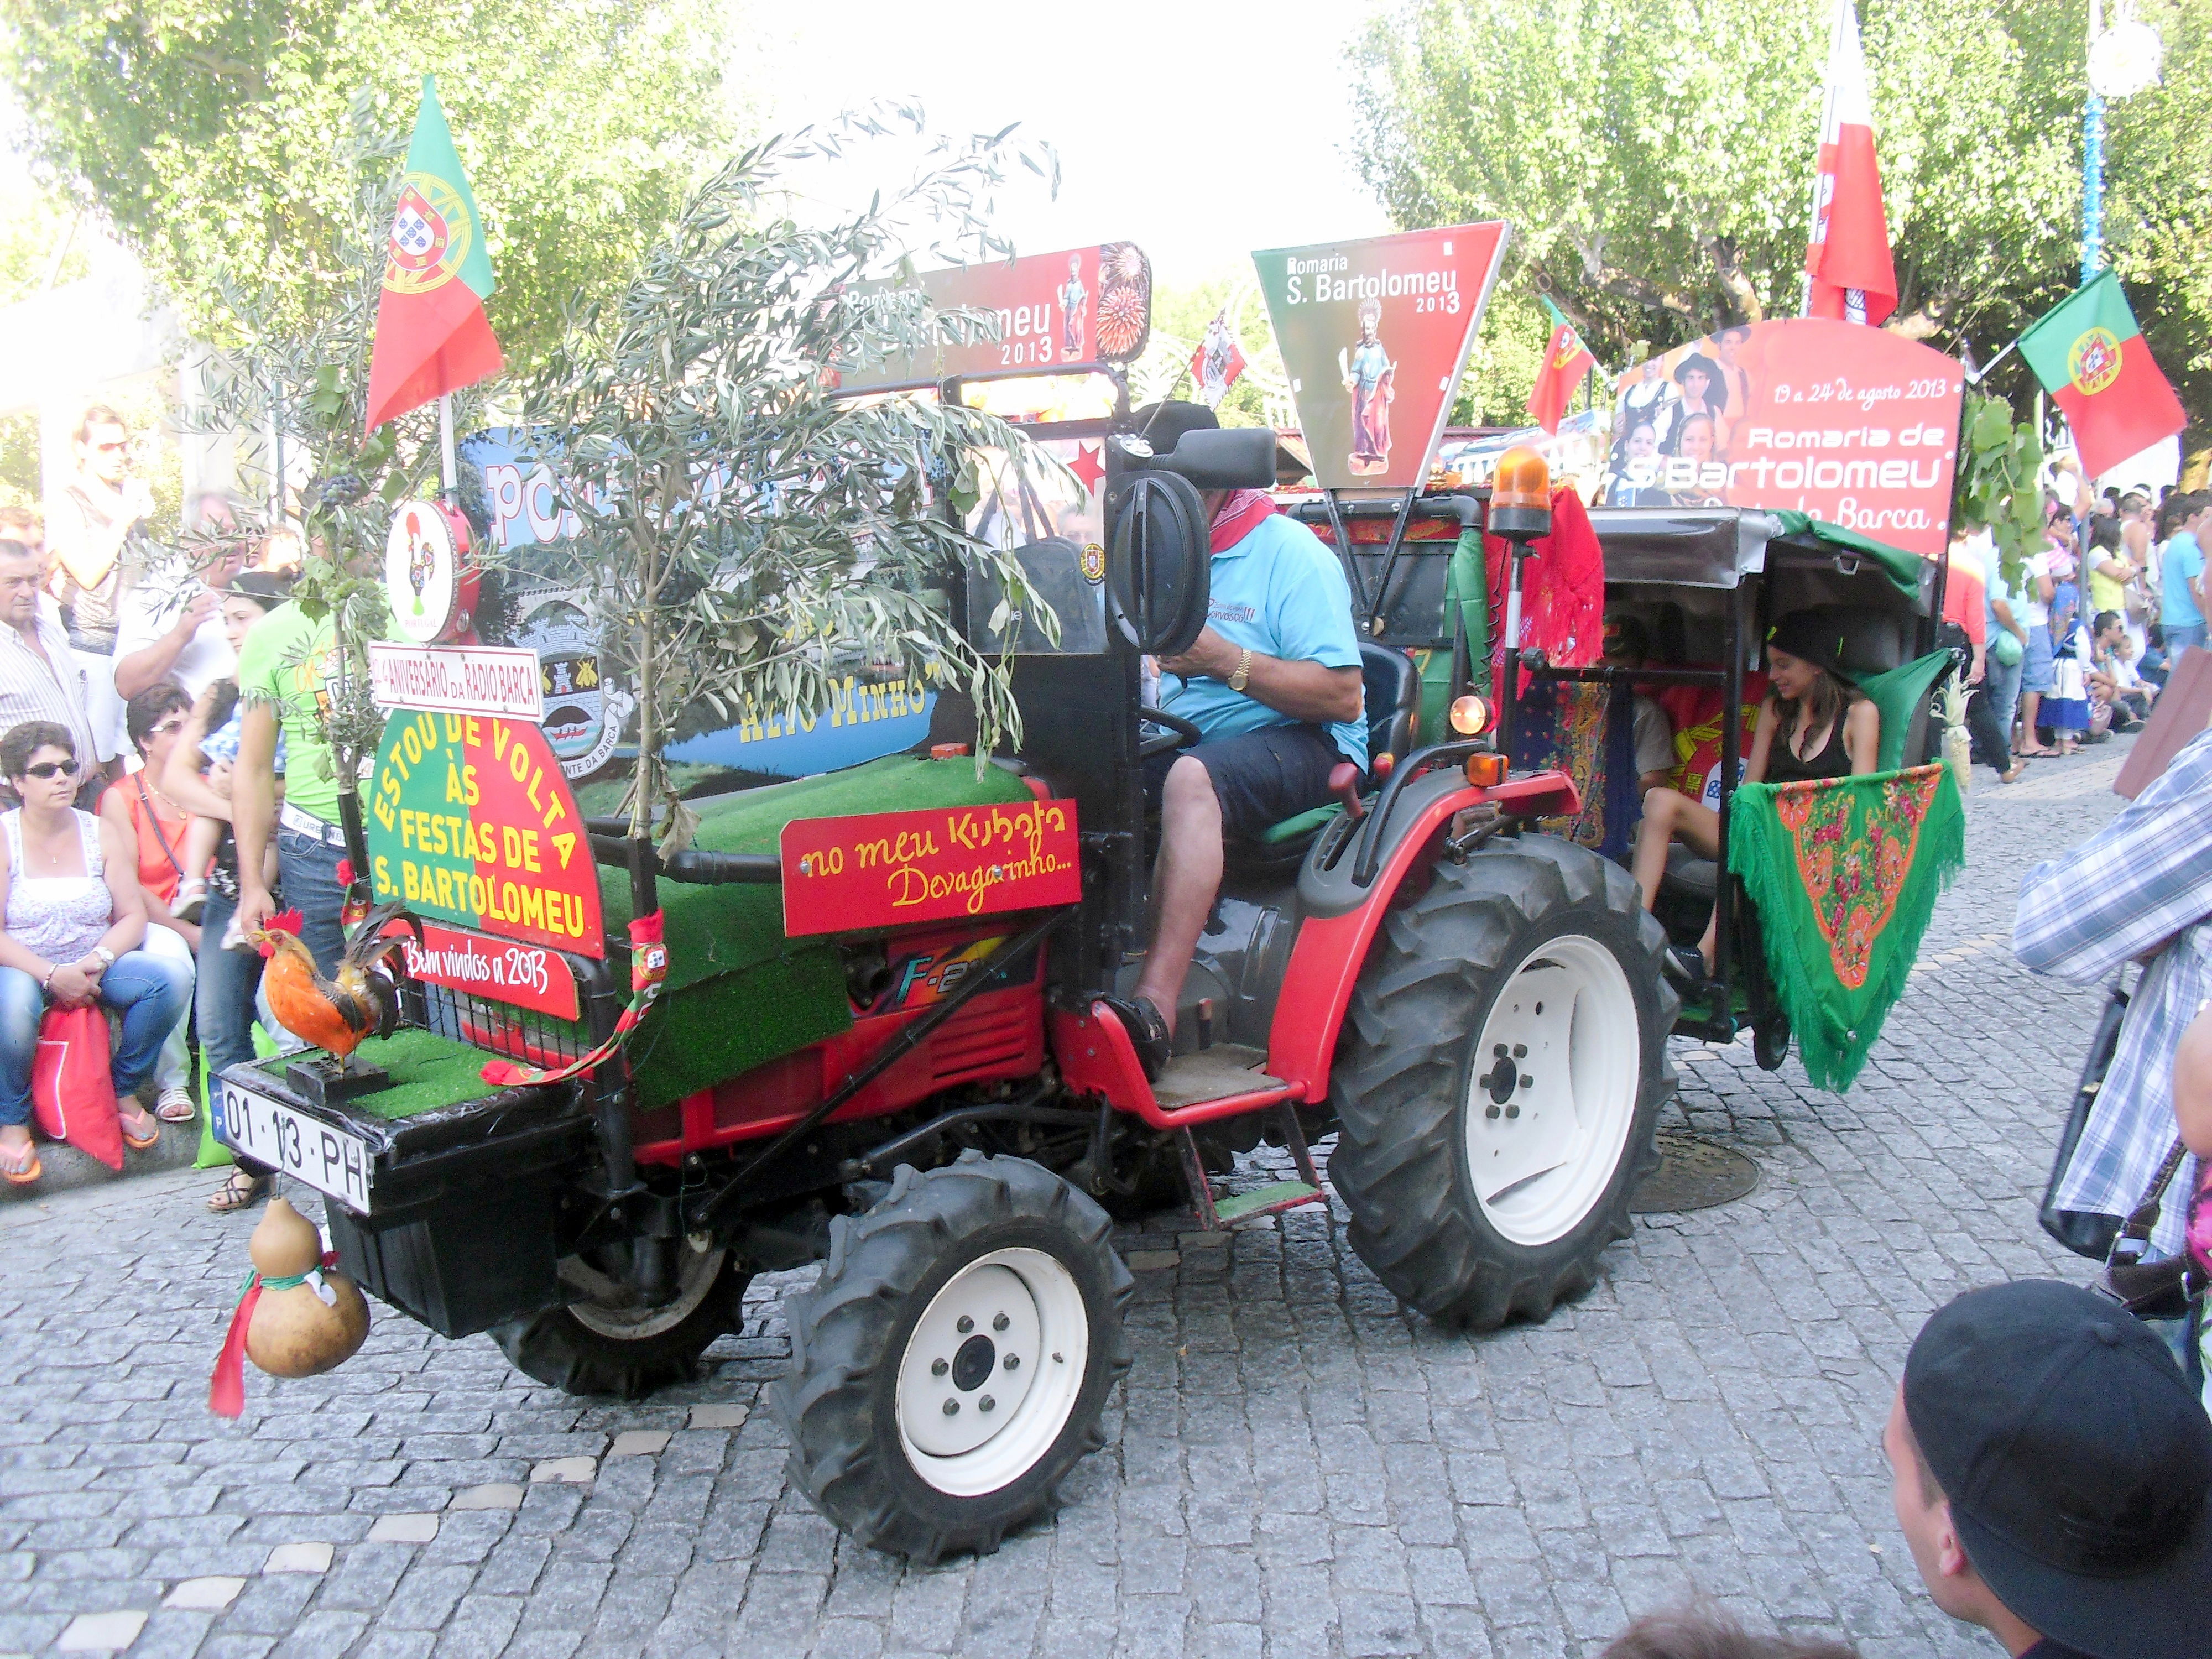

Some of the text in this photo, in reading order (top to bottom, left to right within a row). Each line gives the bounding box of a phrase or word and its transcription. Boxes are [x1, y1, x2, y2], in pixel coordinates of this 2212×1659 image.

[1287, 253, 1348, 275] Romaria
[1287, 269, 1456, 305] S. Bartolomeu
[1416, 291, 1460, 314] 2013
[1001, 335, 1052, 365] 2013
[1774, 378, 1947, 411] 19 a 24 de agosto 2013
[1747, 422, 1945, 449] Romaria de
[1664, 456, 1942, 489] Bartolomeu
[451, 681, 465, 700] DA
[465, 659, 497, 702] RÁDIO
[498, 665, 535, 705] BARCA
[586, 756, 598, 769] DA
[598, 726, 618, 758] BARCA
[374, 712, 577, 870] ESTOU DE VOLTA
[446, 749, 479, 806] ÀS
[400, 809, 541, 873] FESTAS DE
[801, 846, 844, 878] no
[855, 830, 939, 868] meu
[374, 855, 585, 938] S. BARTOLOMEU
[404, 939, 548, 995] Bem vindos a 2013
